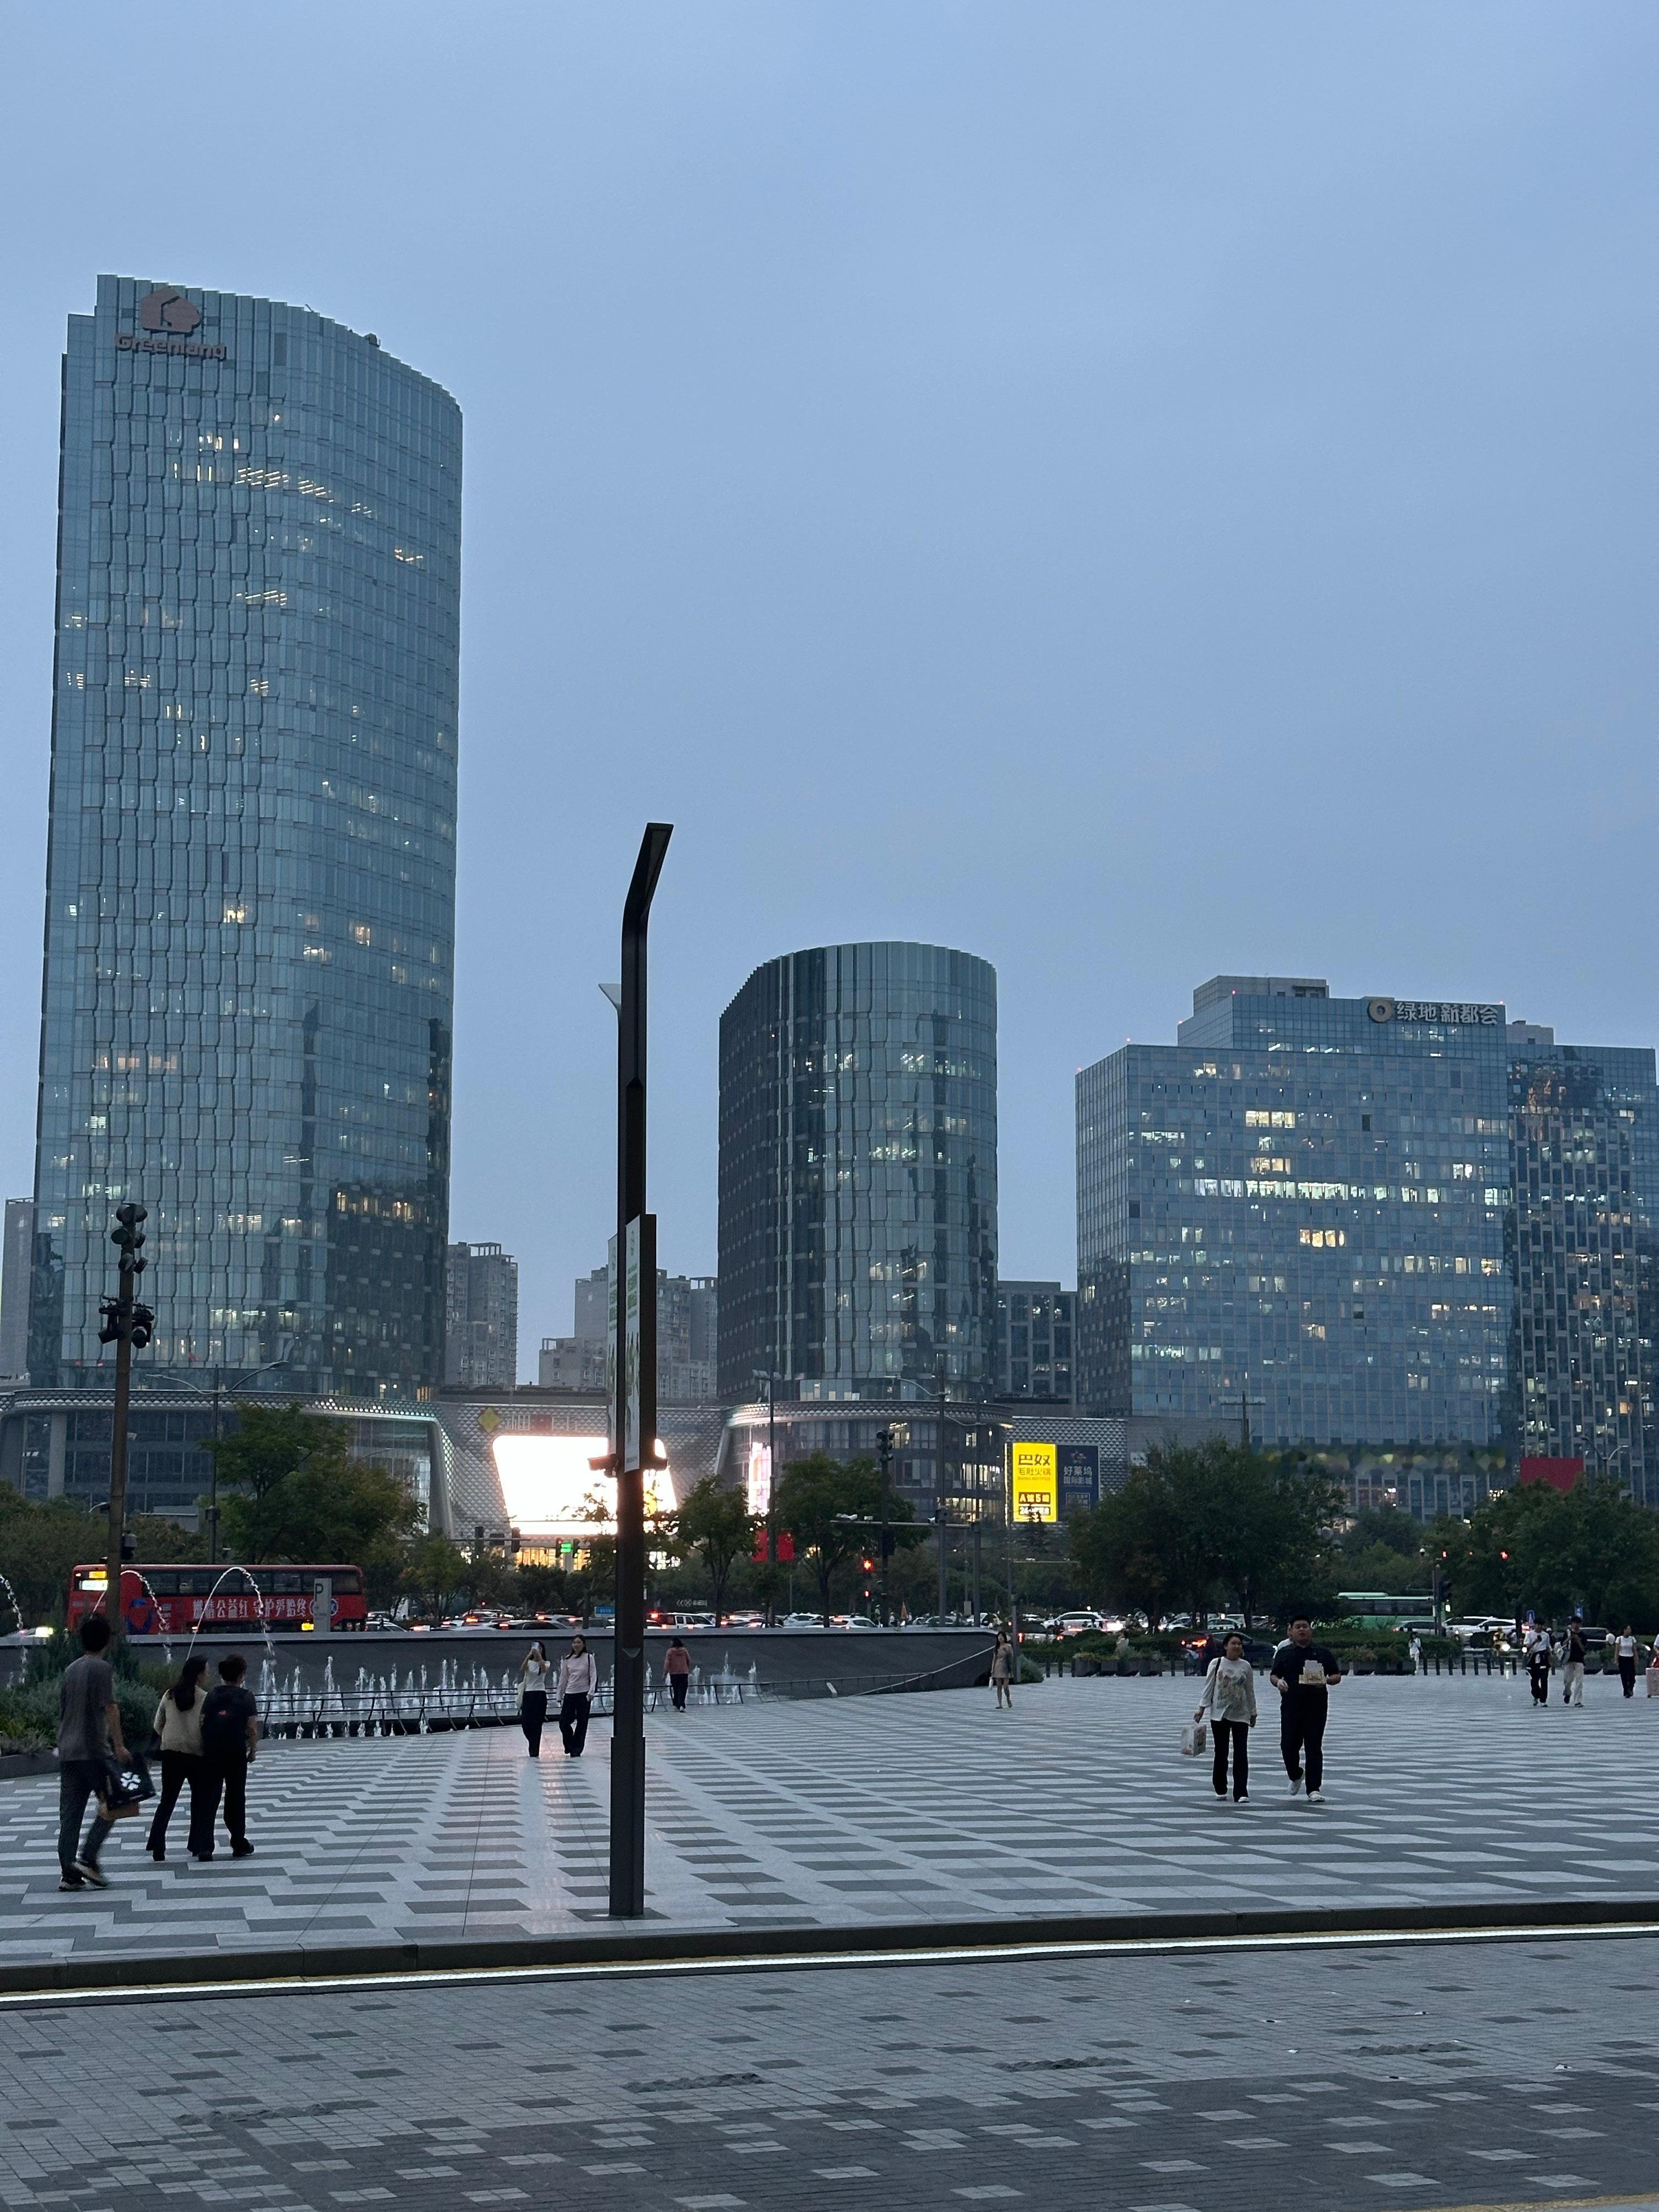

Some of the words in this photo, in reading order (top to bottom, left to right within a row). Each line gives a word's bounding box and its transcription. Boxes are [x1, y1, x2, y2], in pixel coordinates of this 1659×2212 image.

[115, 333, 227, 361] Greenland
[1397, 1001, 1498, 1025] 绿地新都会
[1018, 1454, 1051, 1466] 巴奴
[1018, 1468, 1051, 1476] 毛肚火锅
[1063, 1465, 1092, 1476] 好莱坞
[1063, 1476, 1092, 1485] 国际影城
[315, 1583, 324, 1602] P
